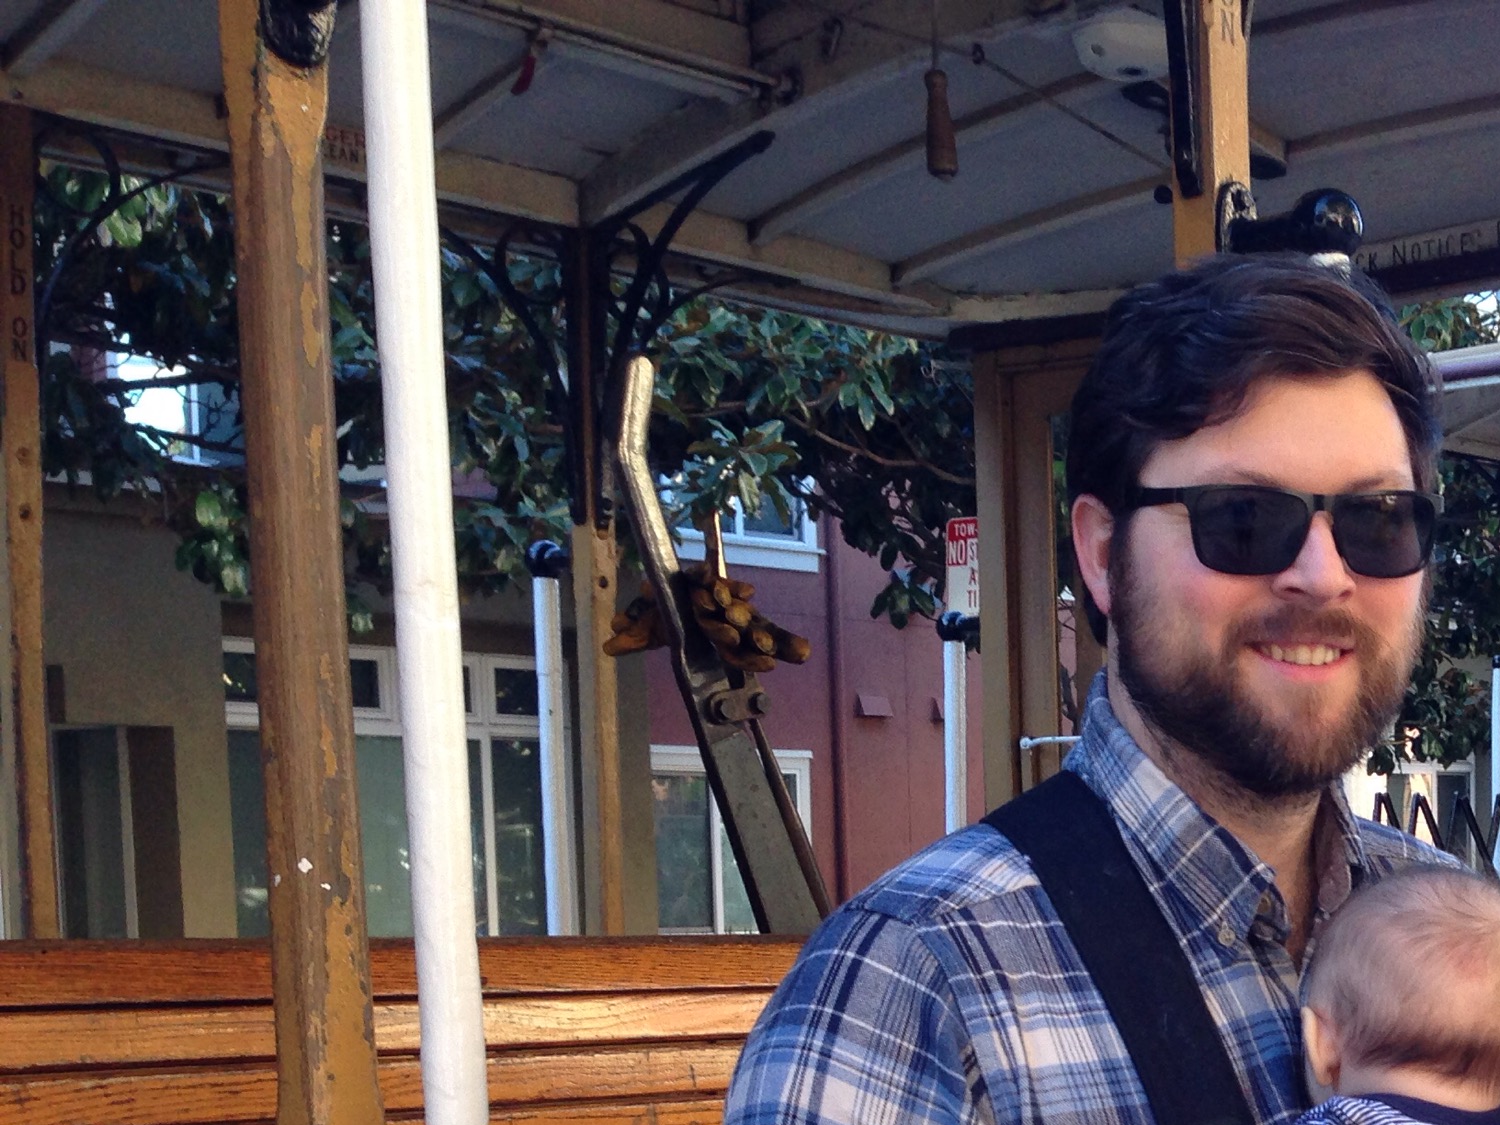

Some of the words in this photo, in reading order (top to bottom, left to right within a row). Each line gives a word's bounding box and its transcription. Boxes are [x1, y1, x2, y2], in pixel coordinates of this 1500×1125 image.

[1220, 0, 1235, 46] N
[9, 204, 26, 296] HOLD
[12, 316, 28, 362] ON
[948, 540, 967, 566] NO
